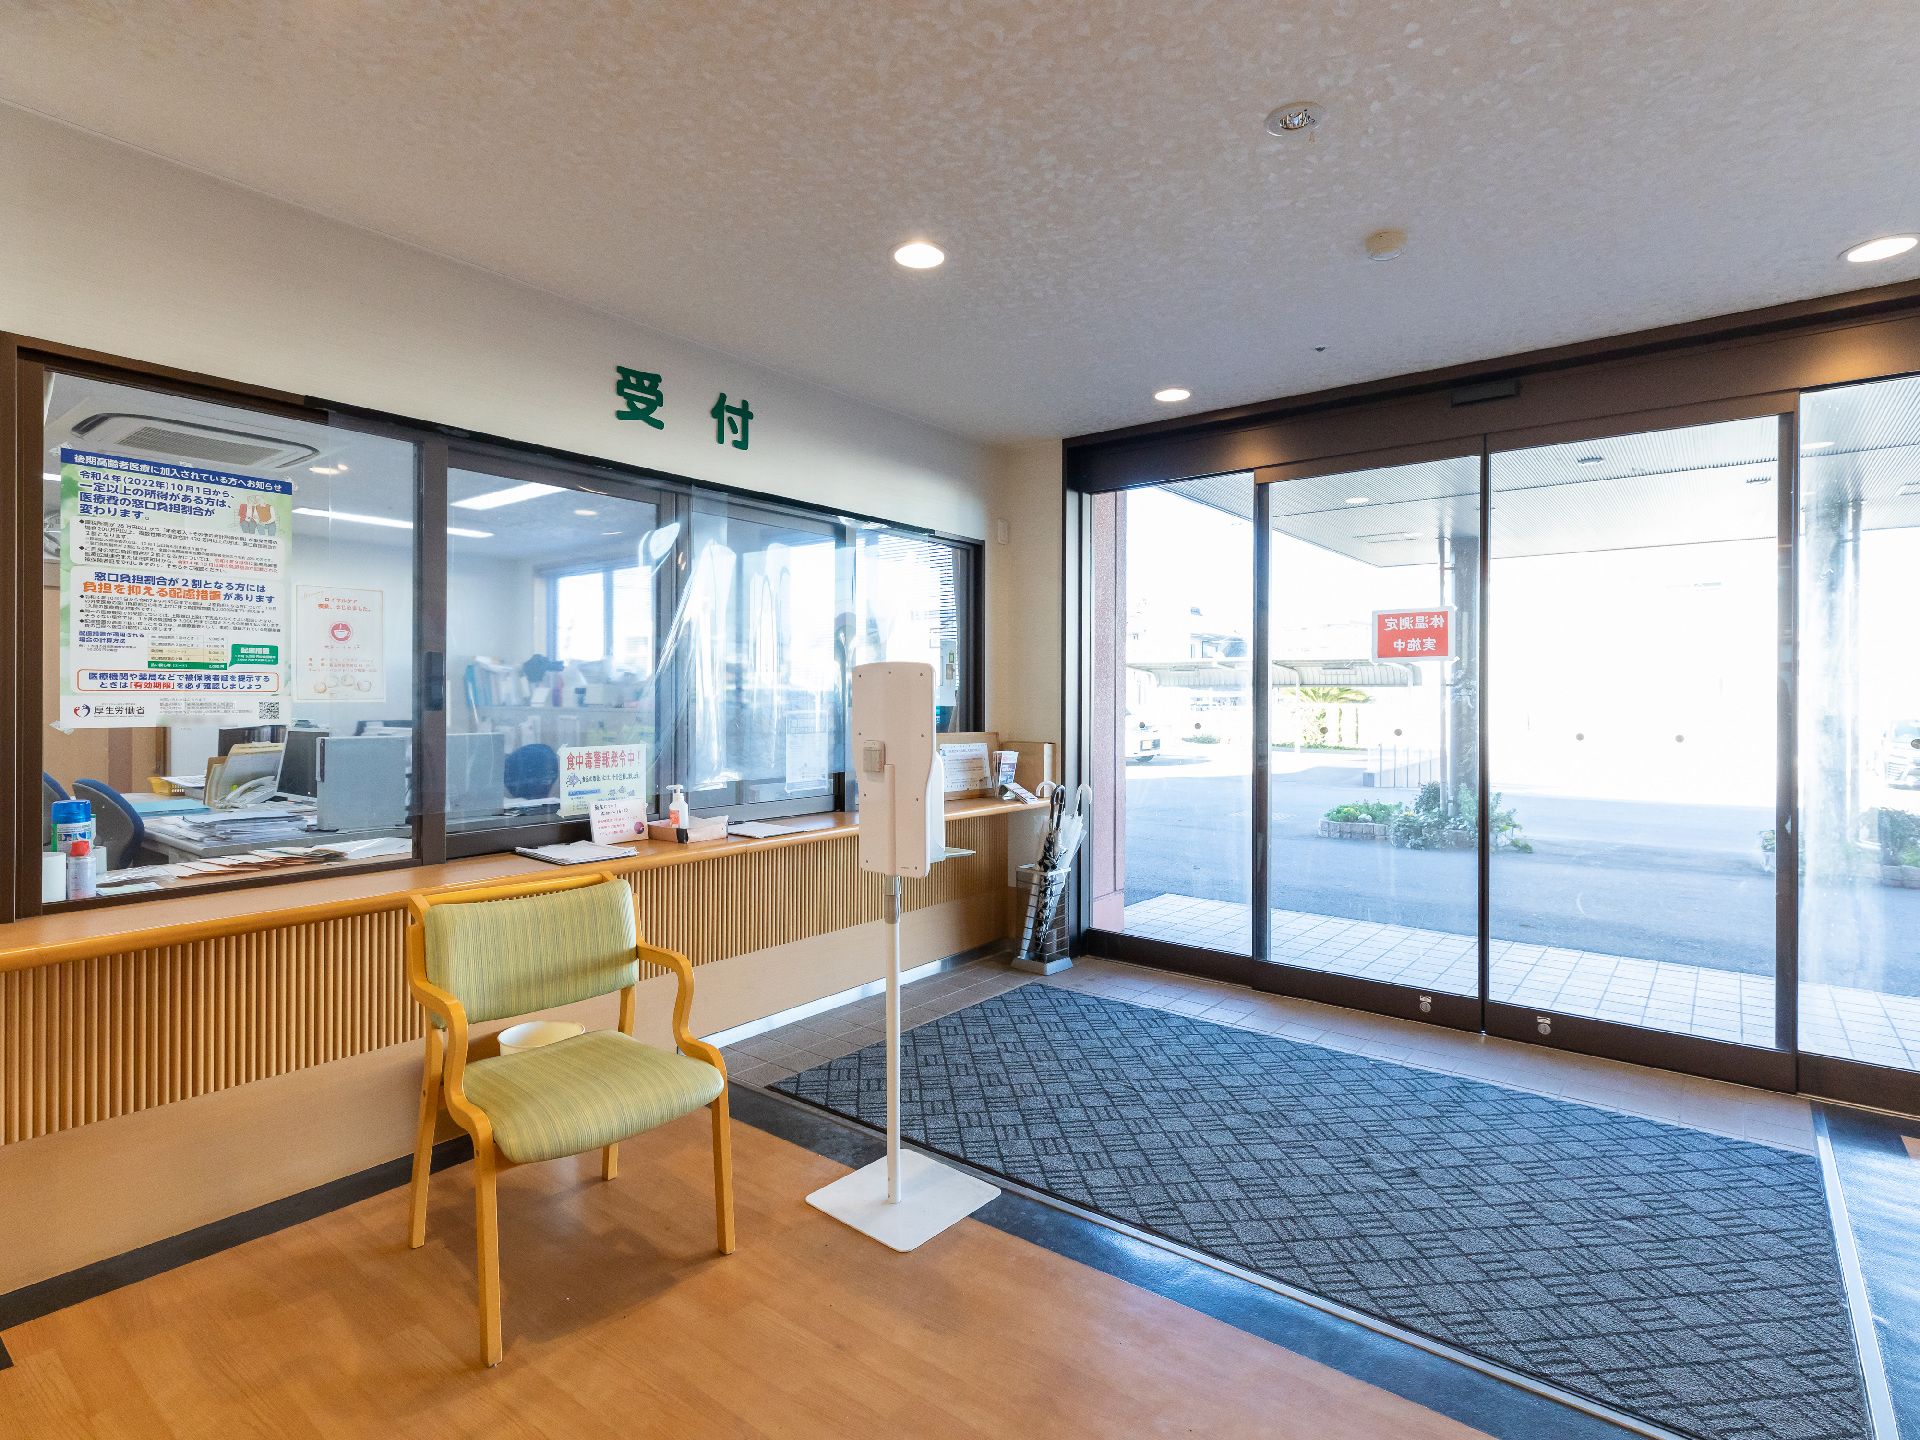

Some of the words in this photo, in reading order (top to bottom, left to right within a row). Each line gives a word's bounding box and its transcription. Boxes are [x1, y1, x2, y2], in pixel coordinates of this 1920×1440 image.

[615, 365, 754, 451] 受付
[74, 454, 282, 492] 後期高齢者医療に加入されている方へお知らせ
[79, 483, 232, 508] 一定以上の所得がある方は、
[79, 494, 216, 517] 医療費の窓口負担割合が
[79, 504, 150, 521] 変わります。
[82, 581, 275, 604] 負担を抑える配慮措置があります
[94, 571, 266, 593] 窓口負担割合が2割となる方には
[94, 706, 145, 716] 厚生労働省
